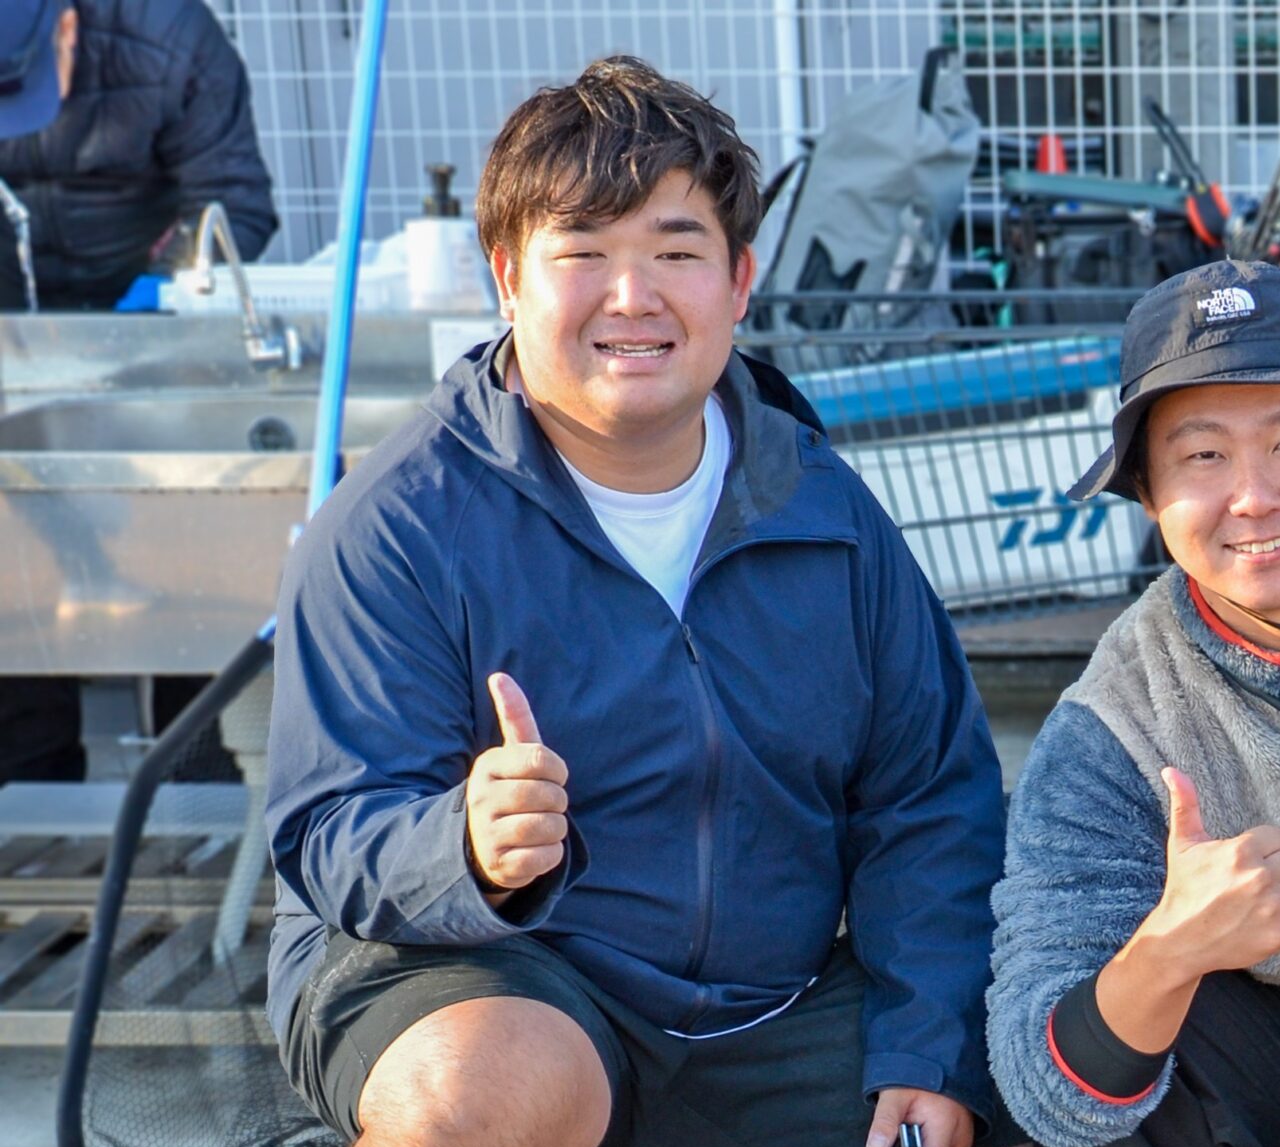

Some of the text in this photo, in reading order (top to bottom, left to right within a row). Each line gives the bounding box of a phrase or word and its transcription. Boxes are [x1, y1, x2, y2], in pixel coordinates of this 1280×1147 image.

[1211, 287, 1233, 299] THE
[1196, 295, 1234, 310] NORTH
[1208, 304, 1236, 316] FACE
